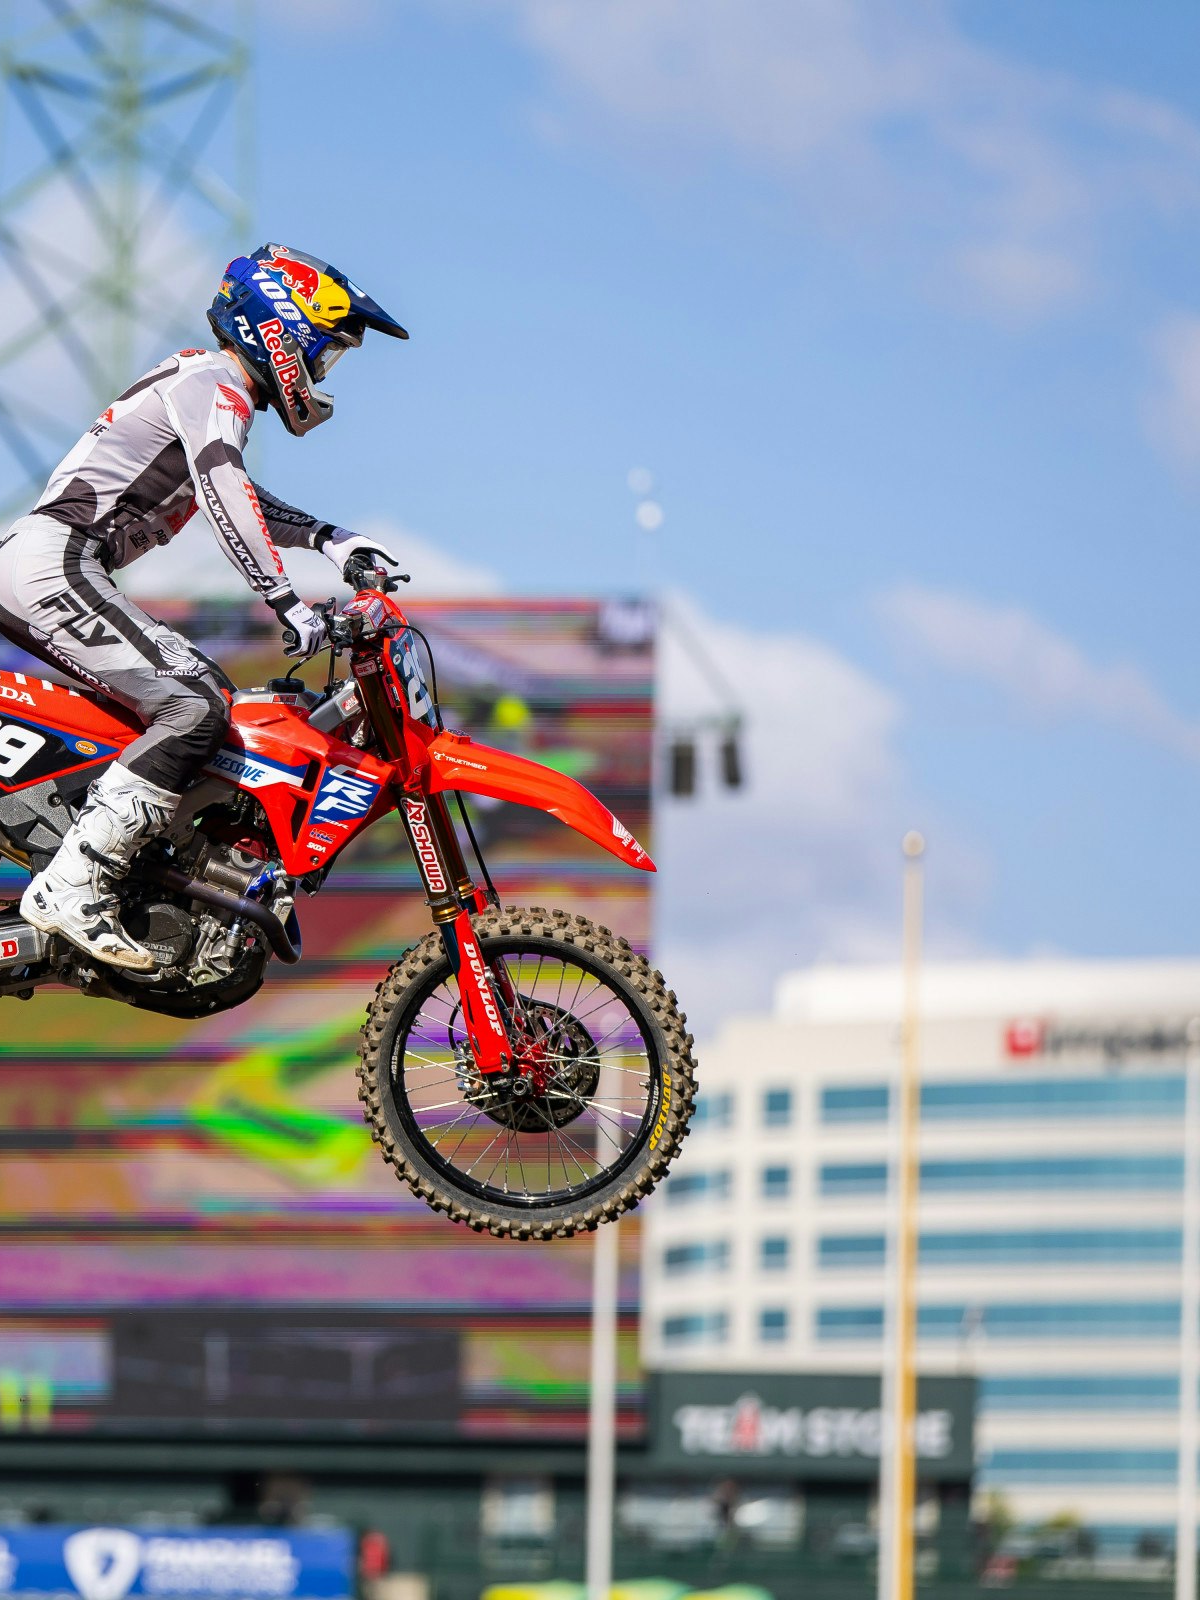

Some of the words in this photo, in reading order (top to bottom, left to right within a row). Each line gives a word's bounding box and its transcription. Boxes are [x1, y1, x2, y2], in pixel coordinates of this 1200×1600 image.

[234, 314, 258, 346] FLY
[243, 481, 285, 576] HONDA
[40, 592, 123, 647] FLY
[45, 641, 112, 693] HONDA
[156, 669, 200, 677] HONDA
[445, 754, 488, 770] TRUETIMBER
[315, 764, 379, 815] CRF
[412, 820, 447, 893] SHOWA
[143, 943, 176, 954] ONDA
[464, 941, 504, 1037] DUNLOP
[649, 1072, 672, 1151] DUNLOP
[673, 1392, 801, 1457] TEAM
[803, 1406, 953, 1458] STOE
